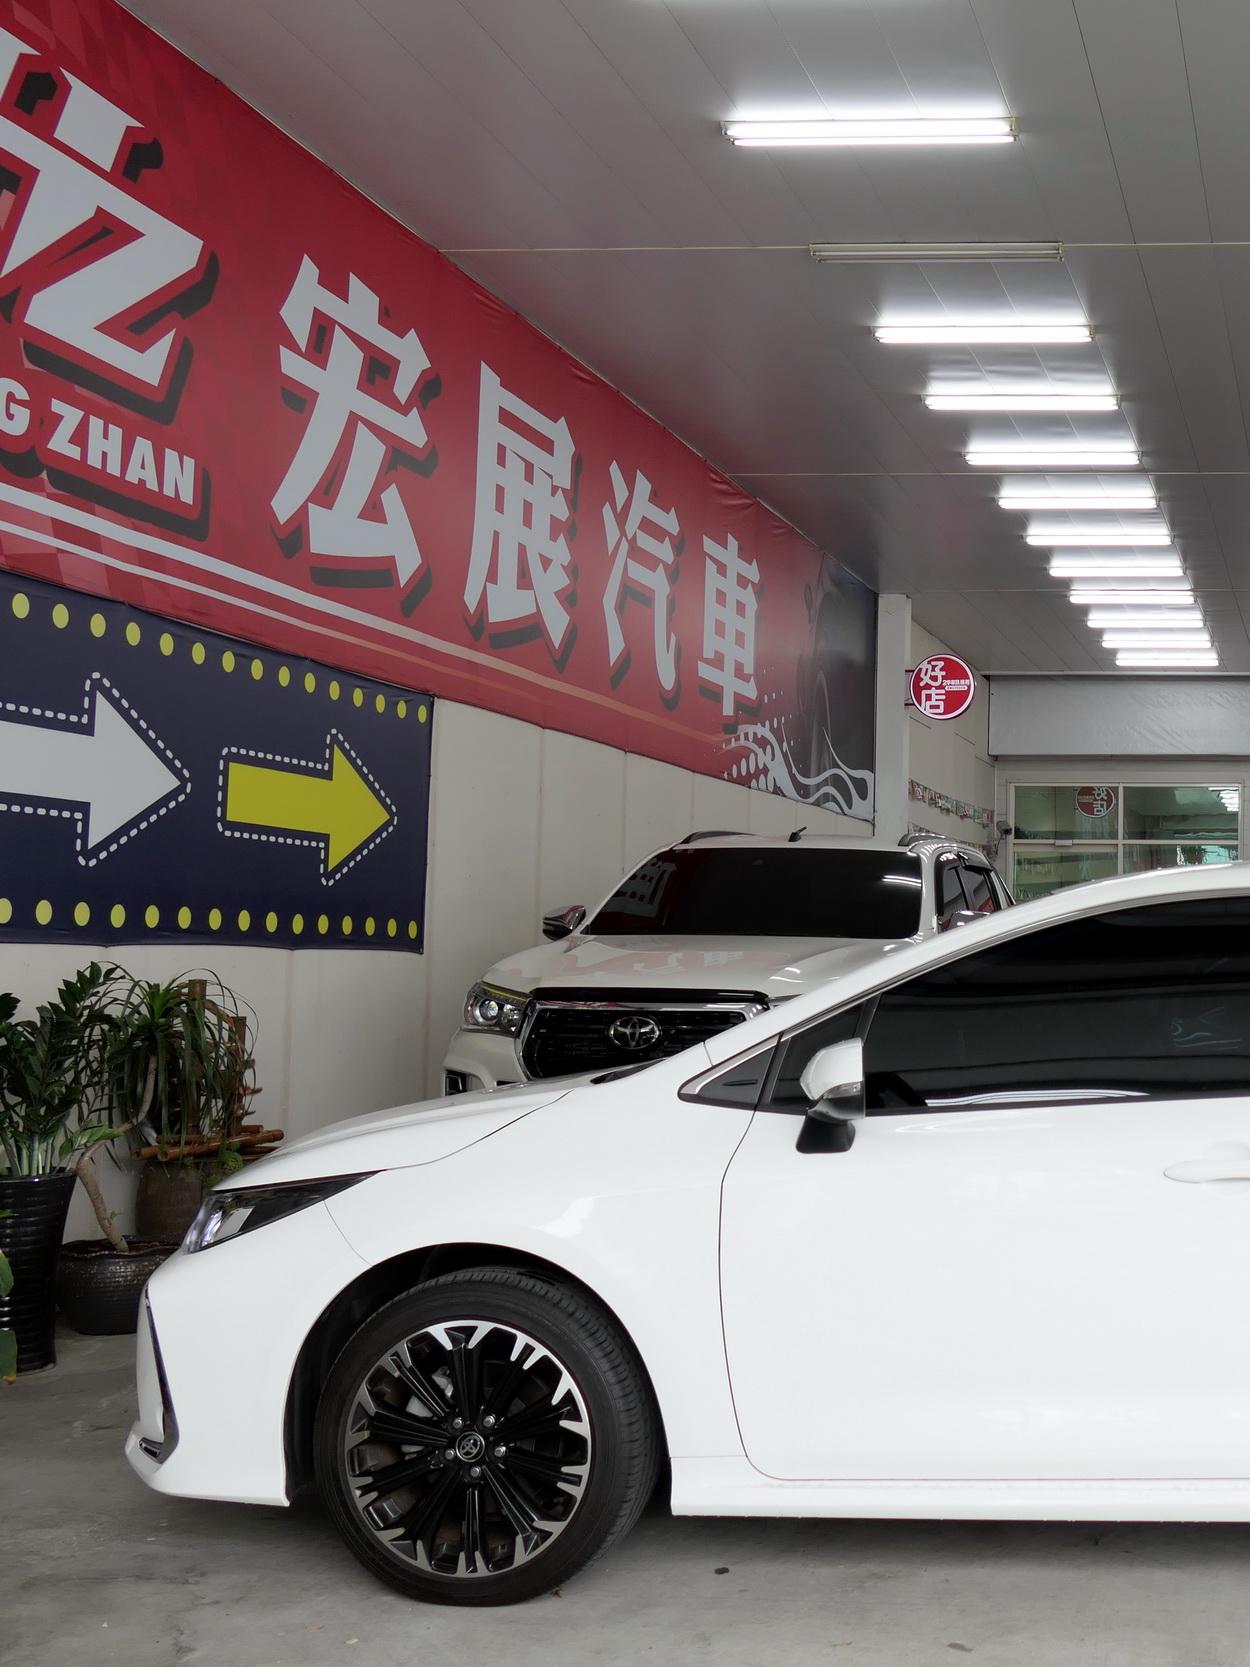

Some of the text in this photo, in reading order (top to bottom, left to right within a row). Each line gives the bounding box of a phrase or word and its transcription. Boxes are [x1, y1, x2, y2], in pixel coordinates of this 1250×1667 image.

[47, 398, 195, 505] ZHAN
[271, 253, 761, 717] 宏展汽車
[919, 661, 945, 714] 好店
